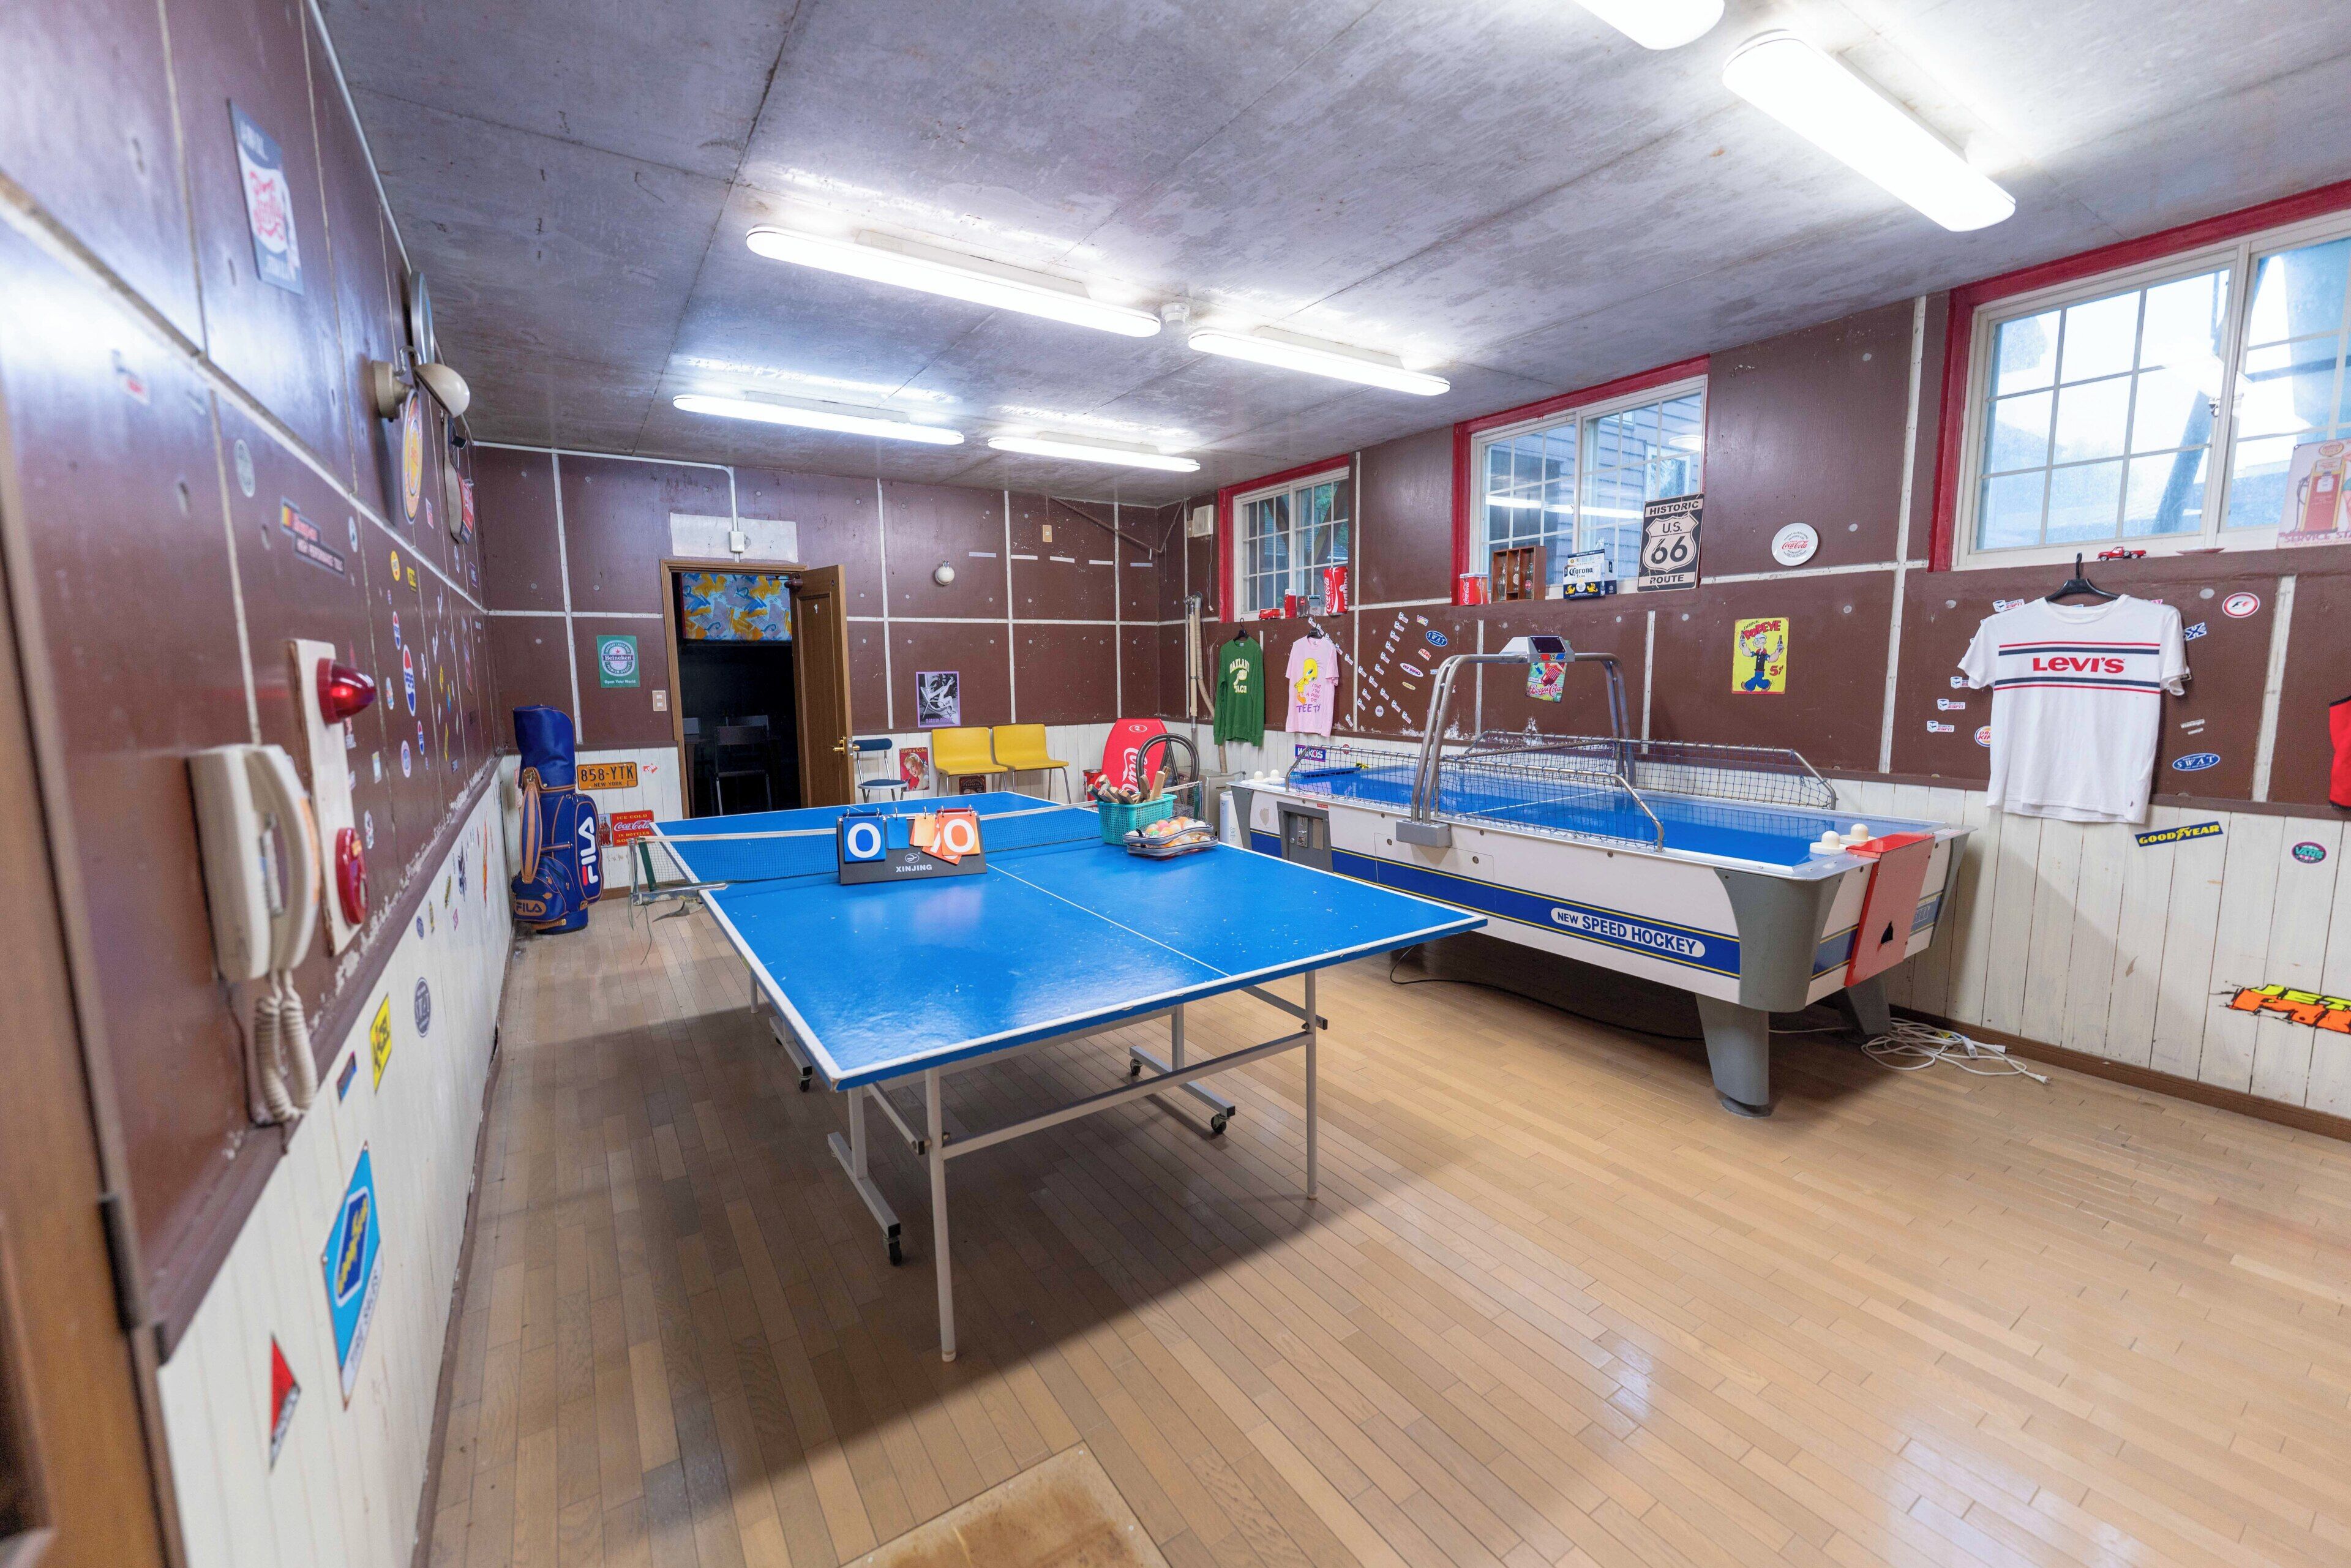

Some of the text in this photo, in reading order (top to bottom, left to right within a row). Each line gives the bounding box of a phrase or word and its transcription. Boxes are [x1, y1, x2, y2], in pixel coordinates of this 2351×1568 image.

[1649, 501, 1699, 515] HISTORIC
[1662, 522, 1682, 533] U.S.
[1651, 536, 1688, 565] 66
[1569, 568, 1593, 577] Corona
[1650, 574, 1684, 584] ROUTE
[1743, 620, 1781, 640] POPEYE
[1744, 620, 1760, 629] DRINK
[1428, 632, 1446, 644] SWAT
[1296, 704, 1321, 713] TEETY
[2177, 756, 2215, 768] SWAT
[581, 765, 634, 781] 858-YTK
[613, 819, 652, 831] Coca-Cola
[578, 817, 598, 886] FILA
[2296, 846, 2323, 859] VANS
[516, 902, 542, 913] FILA
[1558, 912, 1697, 955] NEW SPEED HOCKEY
